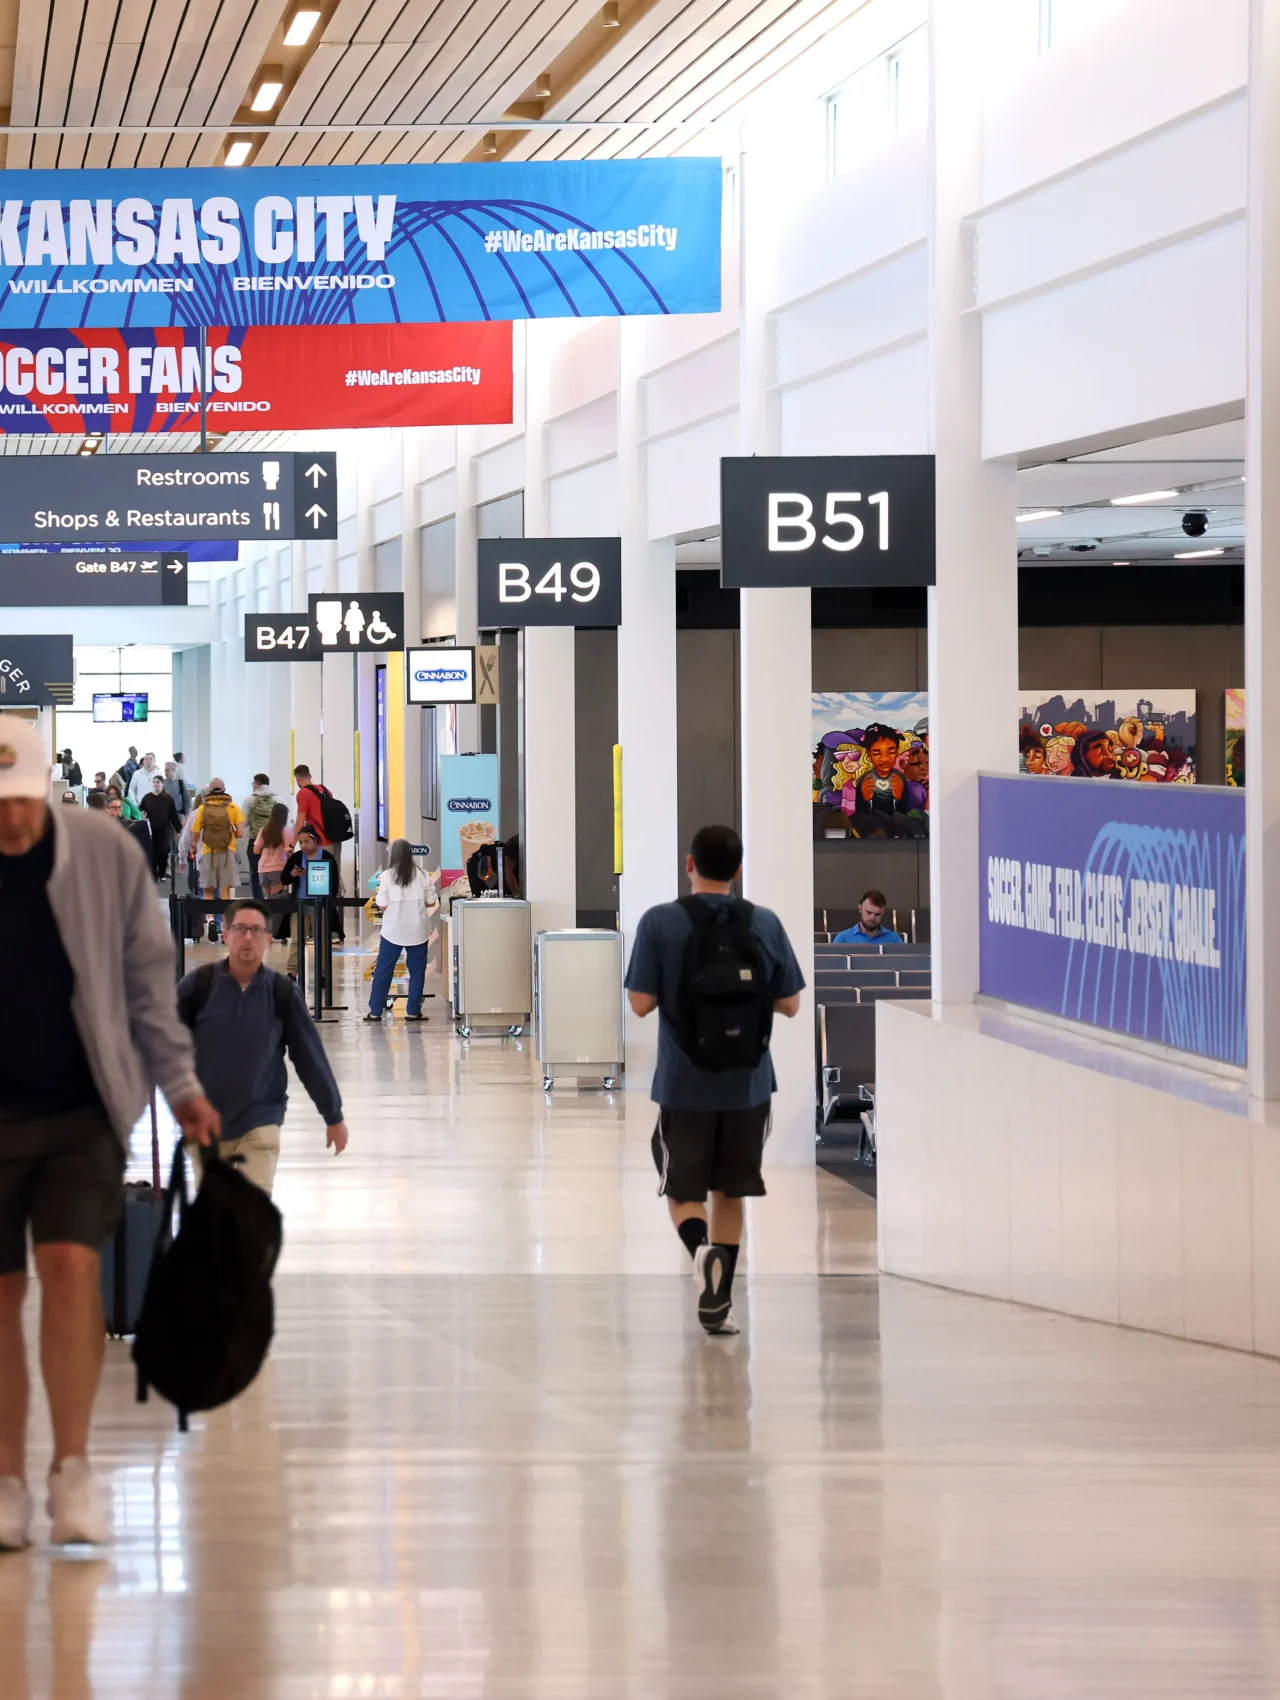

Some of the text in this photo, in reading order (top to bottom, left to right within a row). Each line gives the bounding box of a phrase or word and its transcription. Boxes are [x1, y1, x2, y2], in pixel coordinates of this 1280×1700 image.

[253, 194, 397, 264] CITY
[484, 223, 678, 253] #WeAreKansasCity
[8, 278, 194, 294] WILLKOMMEN
[232, 275, 396, 291] BIENVENIDO
[128, 345, 243, 394] FANS
[344, 365, 481, 387] #WeAreKansasCity
[137, 468, 250, 486] Restrooms
[34, 509, 251, 531] Shops & Restaurants
[768, 491, 889, 552] B51
[75, 561, 137, 574] Gate B47
[498, 561, 601, 603] B49
[256, 626, 309, 650] B47
[416, 671, 465, 681] CINNABON
[449, 800, 489, 810] CINNABON
[312, 874, 325, 882] EXIT
[988, 856, 1220, 968] SOCCER. GAME. FIELD. CLEATS. JERSEY. GOALIE.
